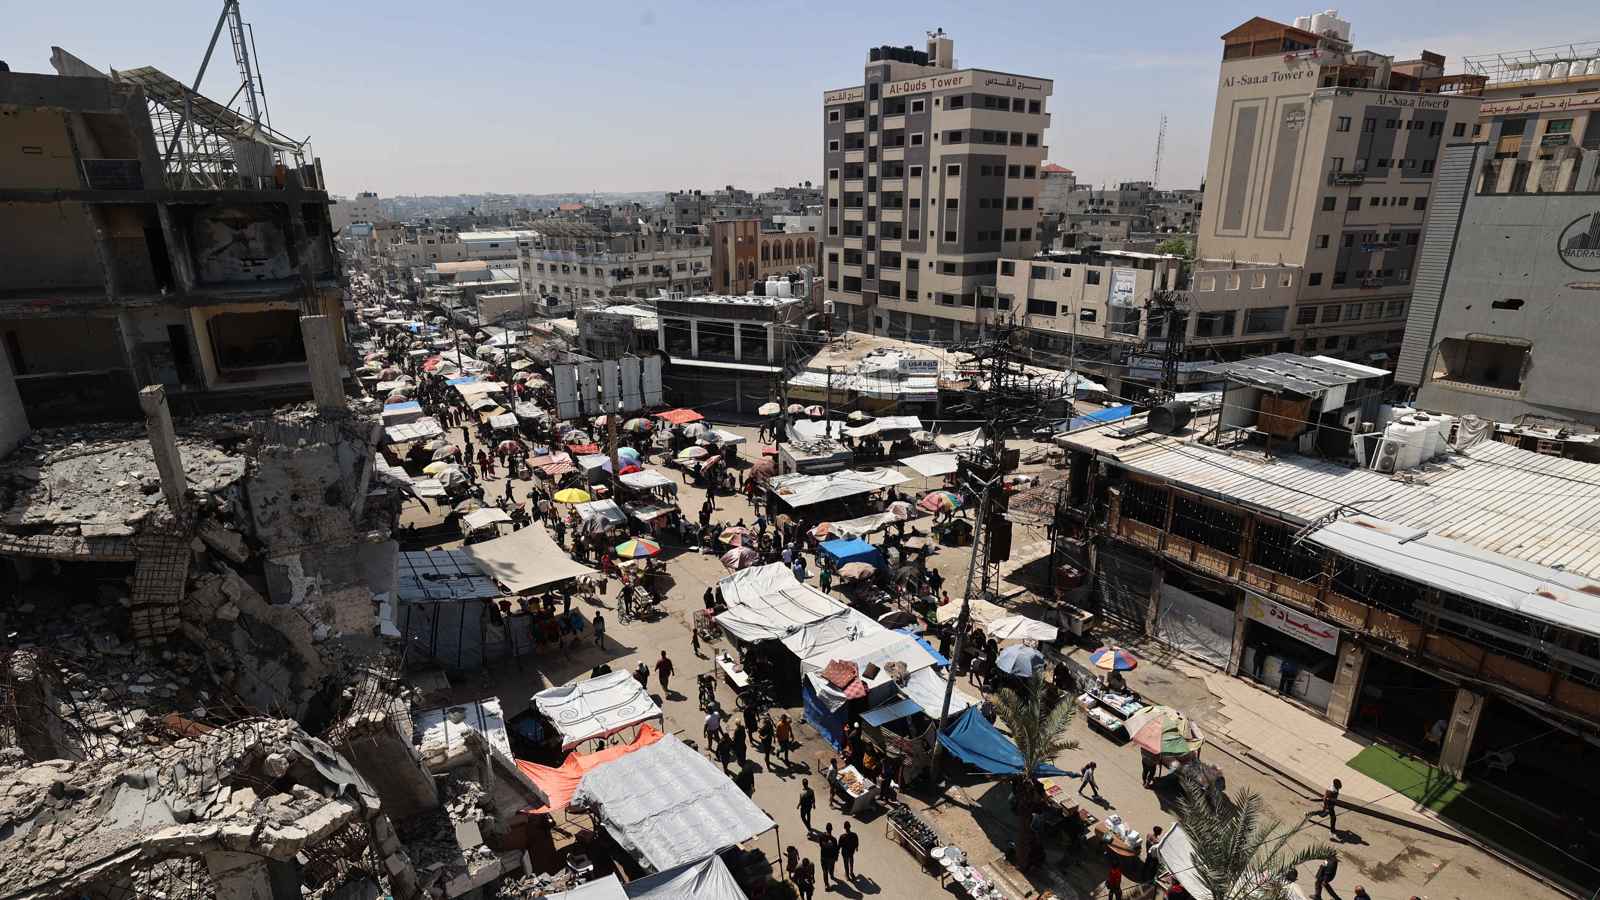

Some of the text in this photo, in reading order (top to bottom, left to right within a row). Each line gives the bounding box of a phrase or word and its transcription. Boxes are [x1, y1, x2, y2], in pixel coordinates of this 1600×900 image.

[889, 76, 963, 96] Al-Quds Tower
[1271, 71, 1304, 82] Tower
[1270, 605, 1335, 639] حمادة
